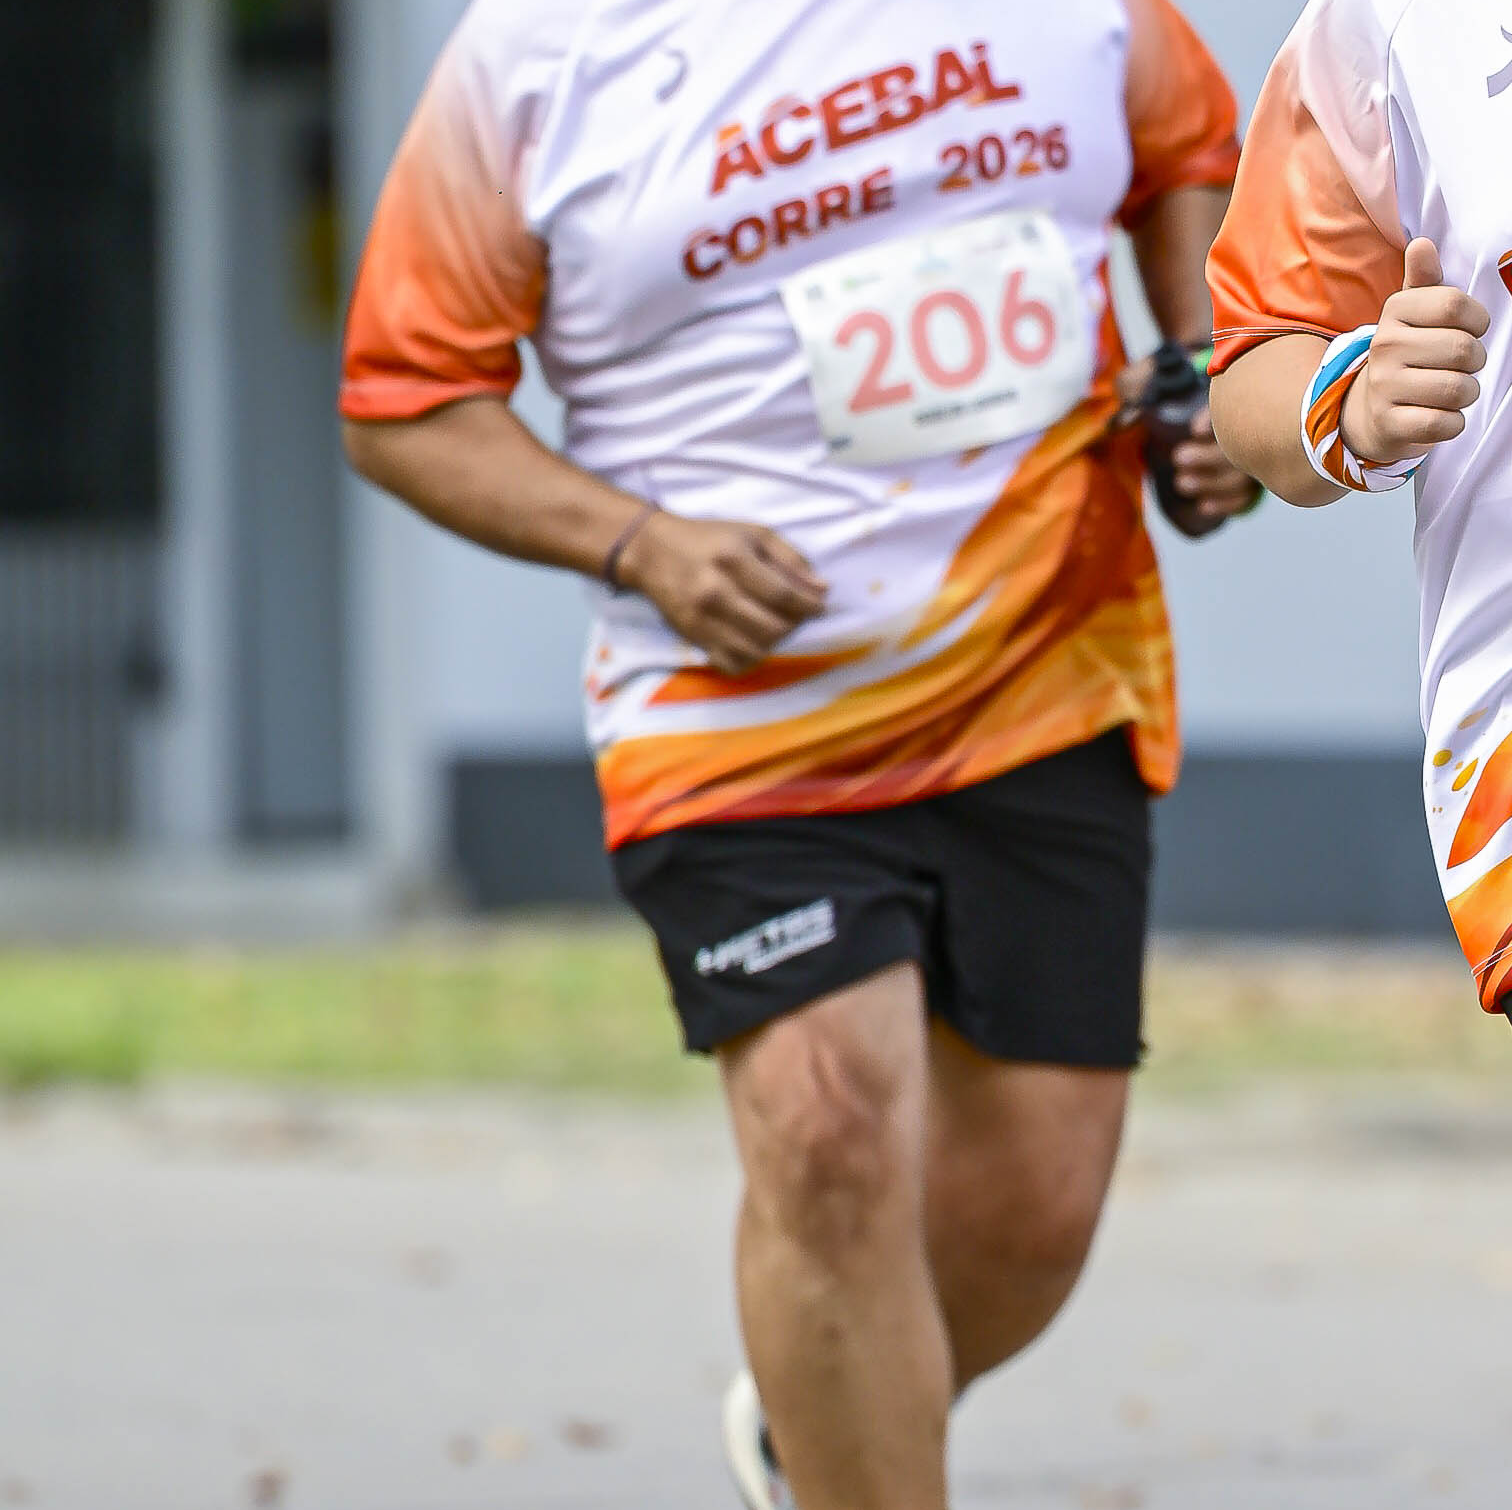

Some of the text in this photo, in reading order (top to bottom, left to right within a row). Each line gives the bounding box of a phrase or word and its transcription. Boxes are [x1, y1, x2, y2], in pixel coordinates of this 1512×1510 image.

[712, 43, 1021, 196] ACEBAL
[682, 126, 1069, 282] CORRE 2026
[834, 269, 1057, 414] 206
